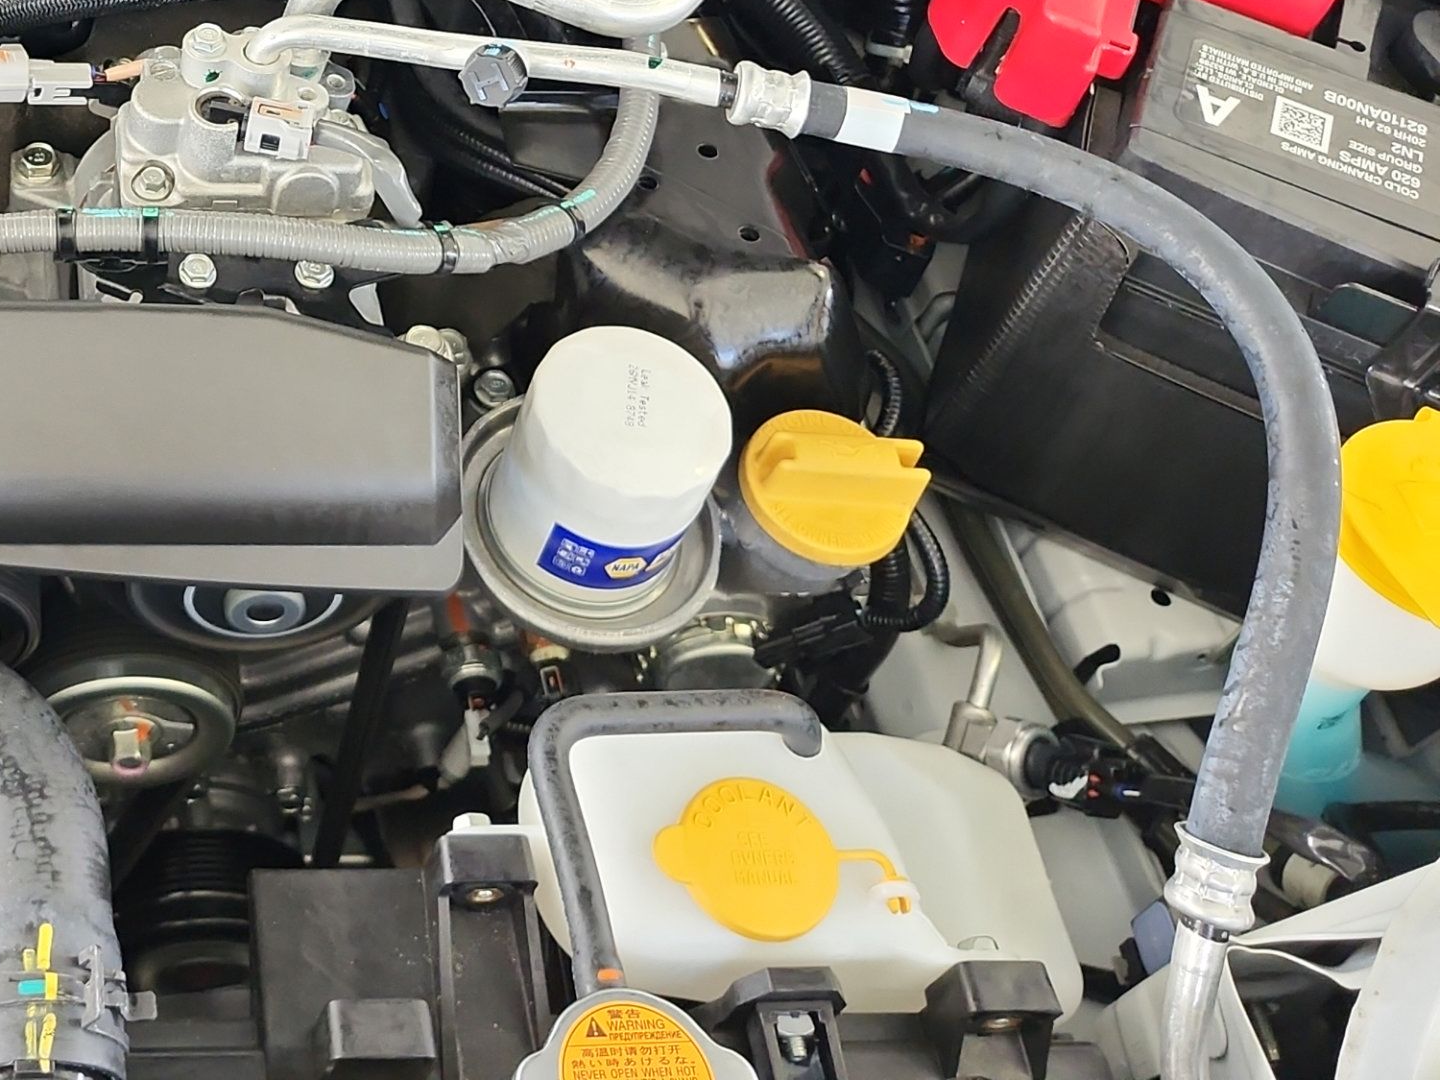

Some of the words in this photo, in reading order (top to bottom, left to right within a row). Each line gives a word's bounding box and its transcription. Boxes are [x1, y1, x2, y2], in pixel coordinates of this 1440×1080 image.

[1195, 84, 1241, 126] A
[1324, 89, 1428, 136] 82110AN00B
[1355, 115, 1375, 129] AH
[1376, 125, 1392, 135] 62
[1348, 140, 1377, 156] SIZE
[1393, 132, 1427, 148] 20HR
[1281, 141, 1317, 161] AMPS
[1391, 141, 1424, 163] LN2
[1317, 155, 1383, 186] CRANKING
[1339, 150, 1389, 177] AMPS
[1377, 151, 1423, 174] GROUP
[1391, 170, 1421, 189] 620
[1384, 180, 1420, 200] COLD
[693, 784, 812, 828] COOLANT
[607, 1009, 641, 1020] 警告
[607, 1019, 666, 1031] WARNING
[609, 1030, 682, 1041] ПРЕДУПРЕЖДЕНИЕ
[582, 1044, 682, 1058] 高温时请勿打开
[573, 1069, 607, 1080] NEVER
[611, 1068, 638, 1079] OPEN
[641, 1067, 672, 1077] WHEN
